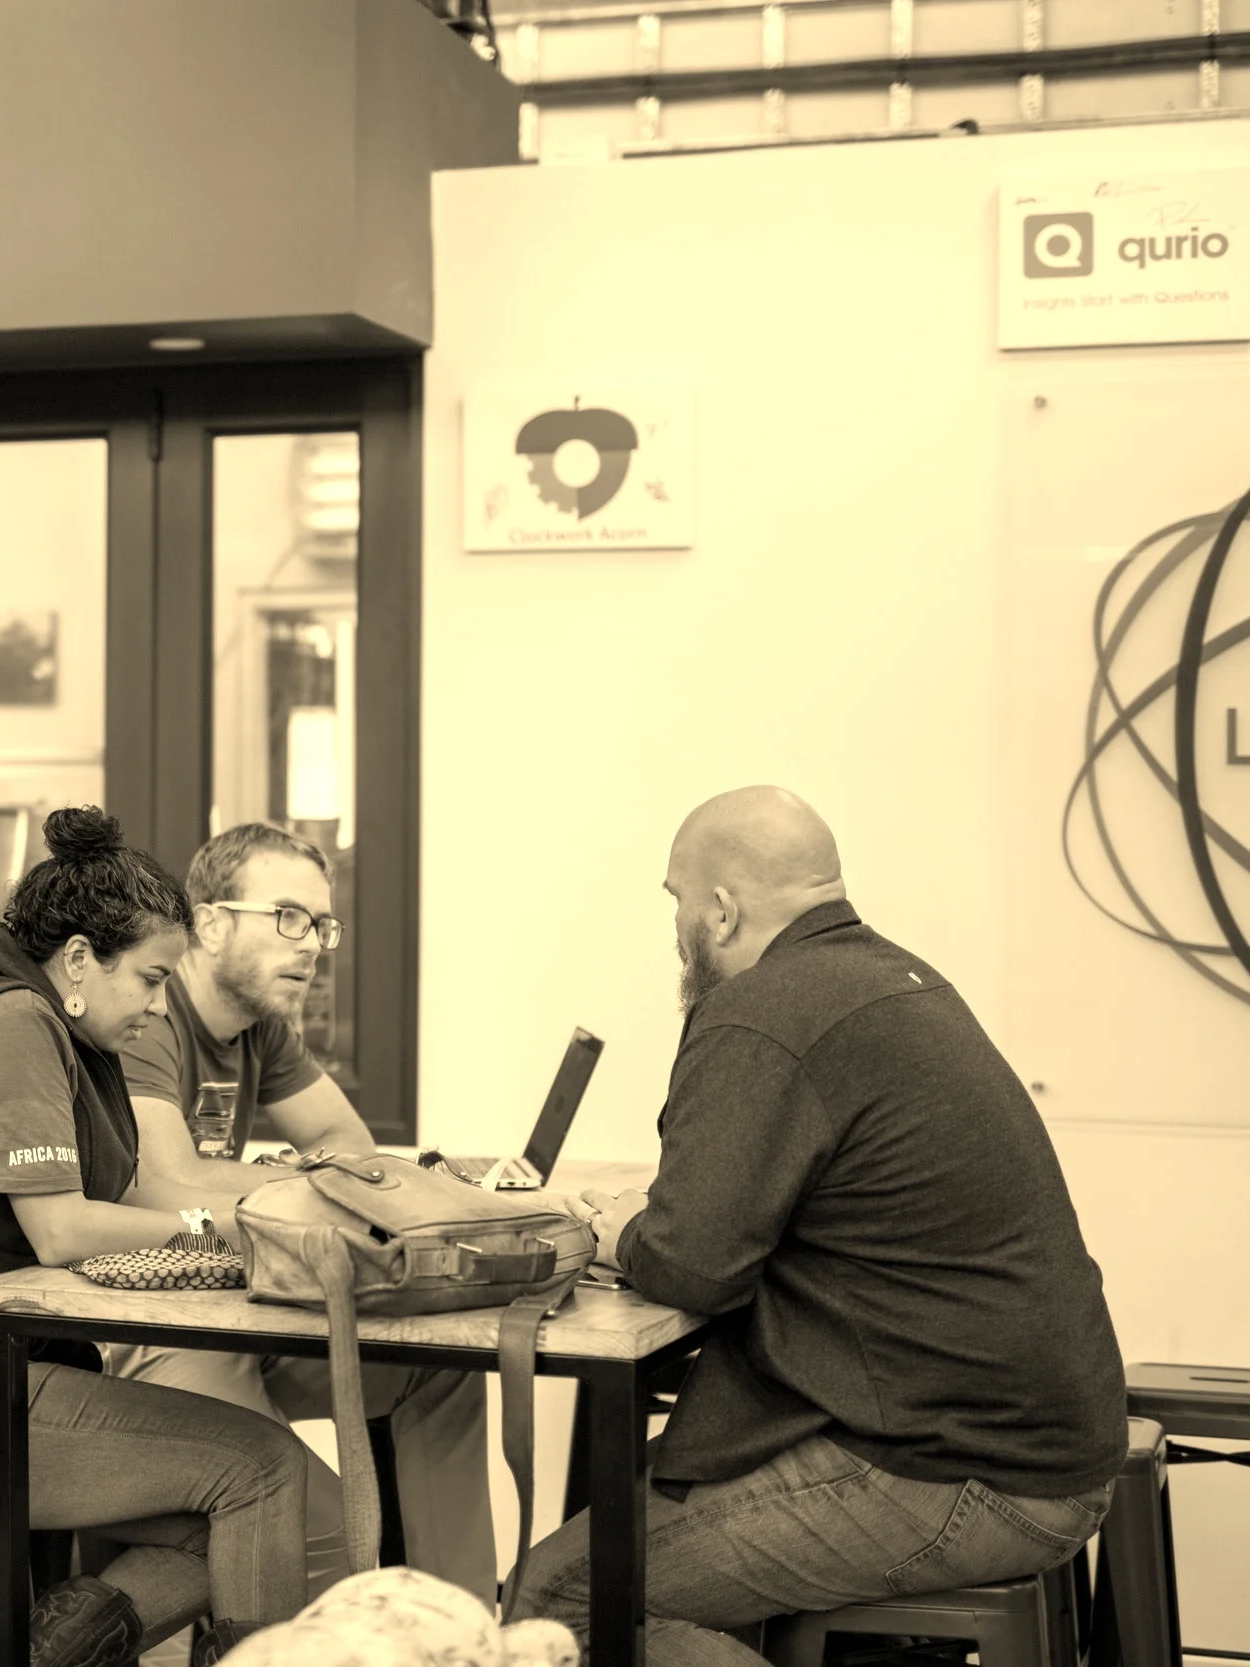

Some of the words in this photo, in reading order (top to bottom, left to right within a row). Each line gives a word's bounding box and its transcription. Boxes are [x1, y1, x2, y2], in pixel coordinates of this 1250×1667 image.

[1118, 226, 1229, 269] qurio
[1022, 295, 1076, 311] Insights
[1081, 293, 1113, 308] Start
[1119, 291, 1149, 306] with
[1154, 288, 1230, 304] Questions
[508, 526, 594, 544] Clockwork
[599, 526, 647, 541] Acorn
[8, 1145, 54, 1167] AFRICA
[55, 1146, 77, 1164] 2016
